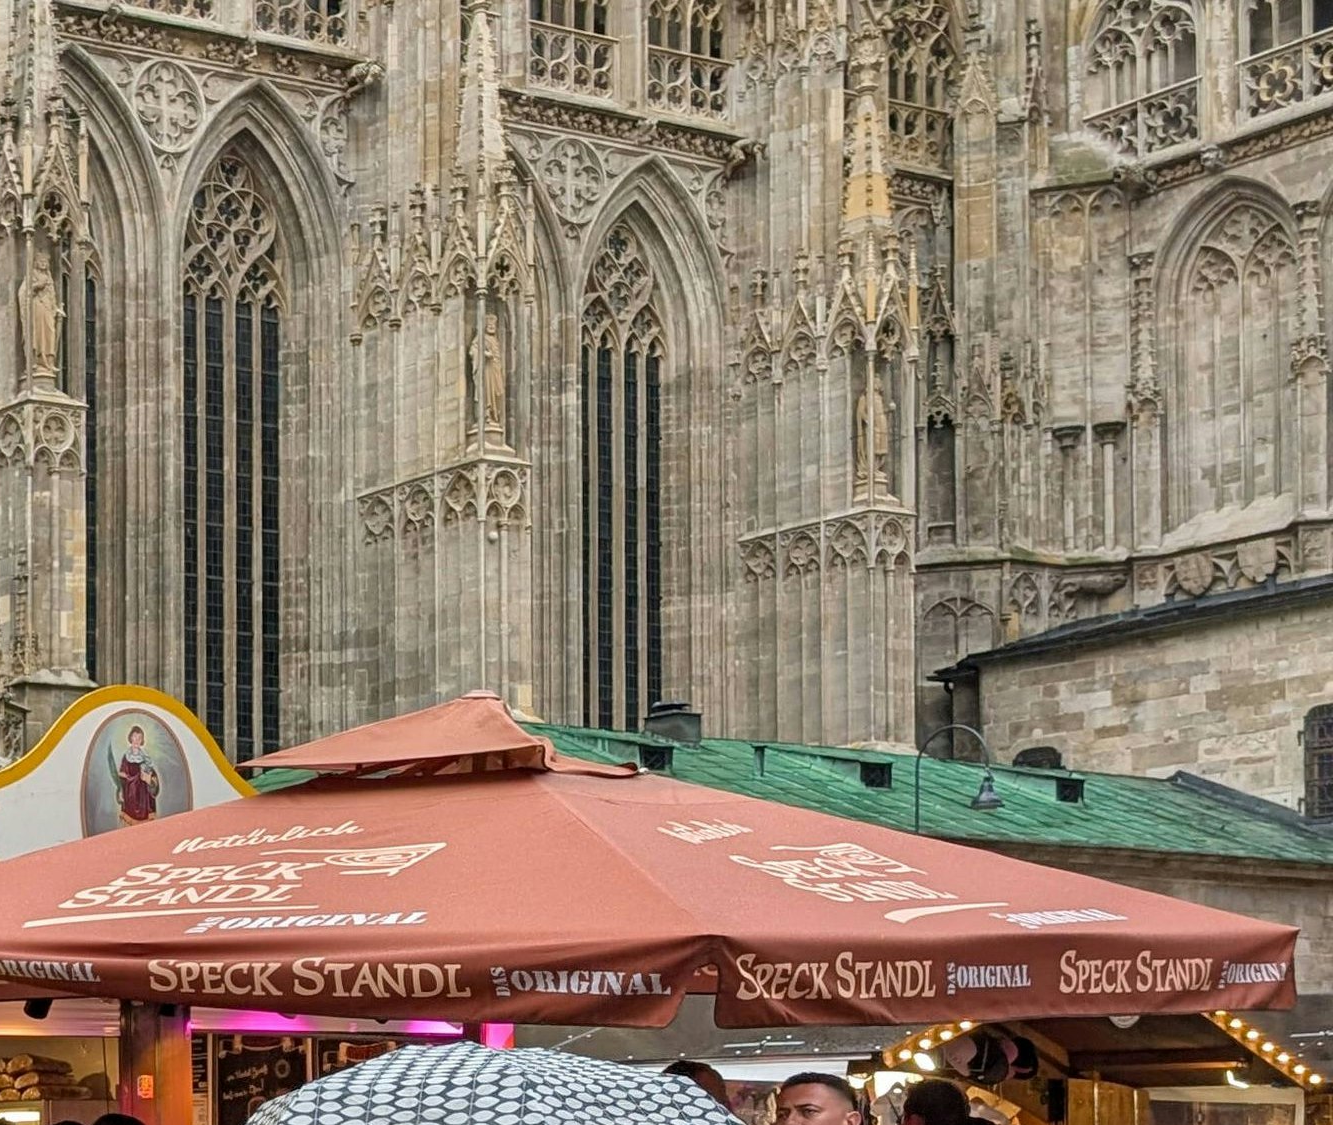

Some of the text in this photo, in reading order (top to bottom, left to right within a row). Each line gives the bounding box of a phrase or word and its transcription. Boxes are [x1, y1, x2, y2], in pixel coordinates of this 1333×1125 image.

[58, 883, 302, 910] STANDL
[218, 911, 428, 930] ORIGINAL
[148, 958, 284, 996] SPECK
[291, 956, 472, 999] STANDL
[510, 969, 672, 997] ORIGINAL
[735, 952, 833, 1001] SPECK
[835, 950, 936, 1000] STANDL
[957, 963, 1032, 989] ORIGINAL
[1059, 949, 1132, 994] SPECK
[1135, 949, 1213, 994] STANDL
[1227, 962, 1287, 984] ORIGIN
